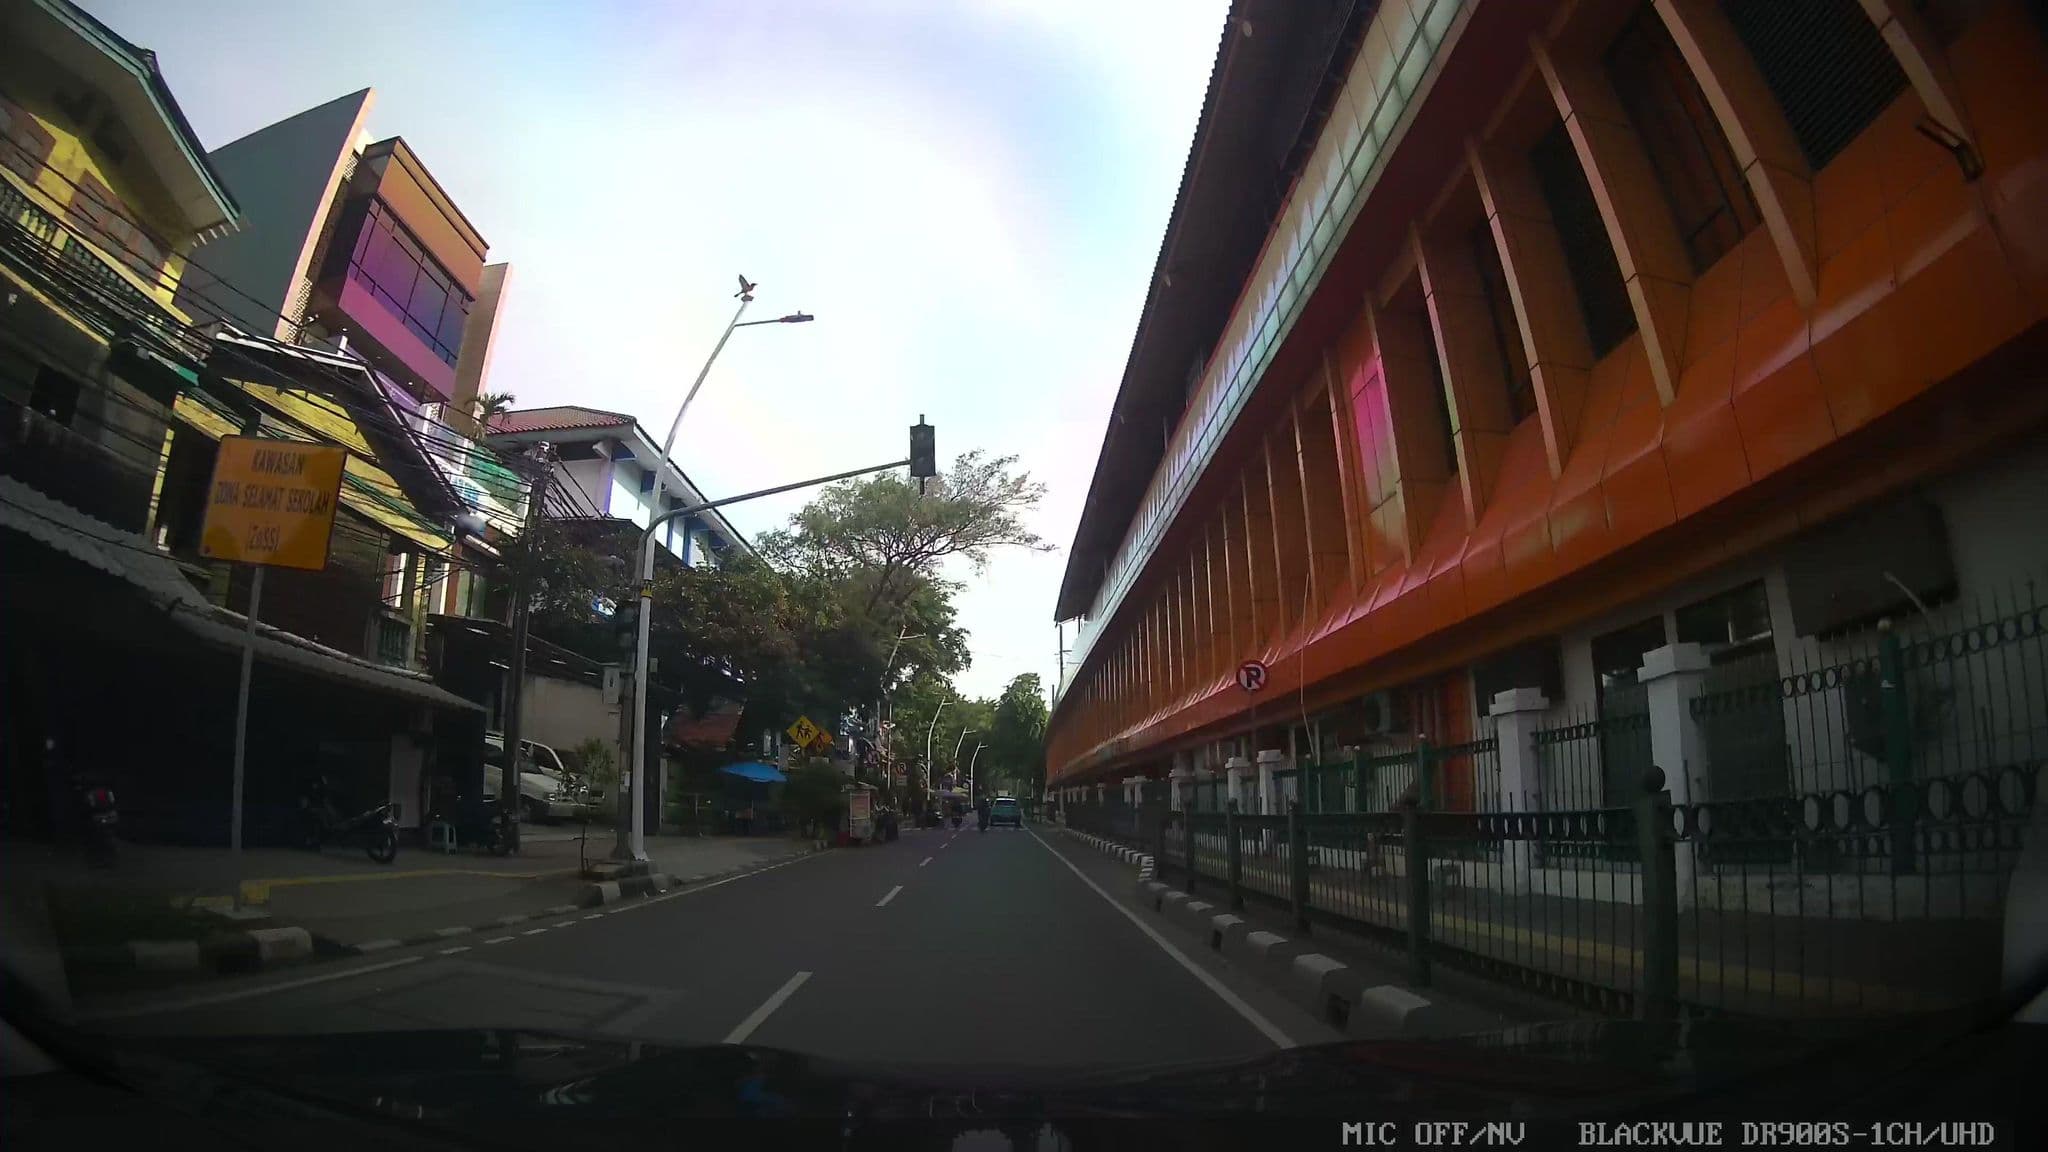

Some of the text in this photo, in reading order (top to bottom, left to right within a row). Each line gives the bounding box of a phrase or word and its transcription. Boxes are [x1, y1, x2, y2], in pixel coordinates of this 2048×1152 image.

[252, 448, 306, 476] KAWASAN
[214, 480, 331, 516] ZONA SELAMAT SEKOLAH
